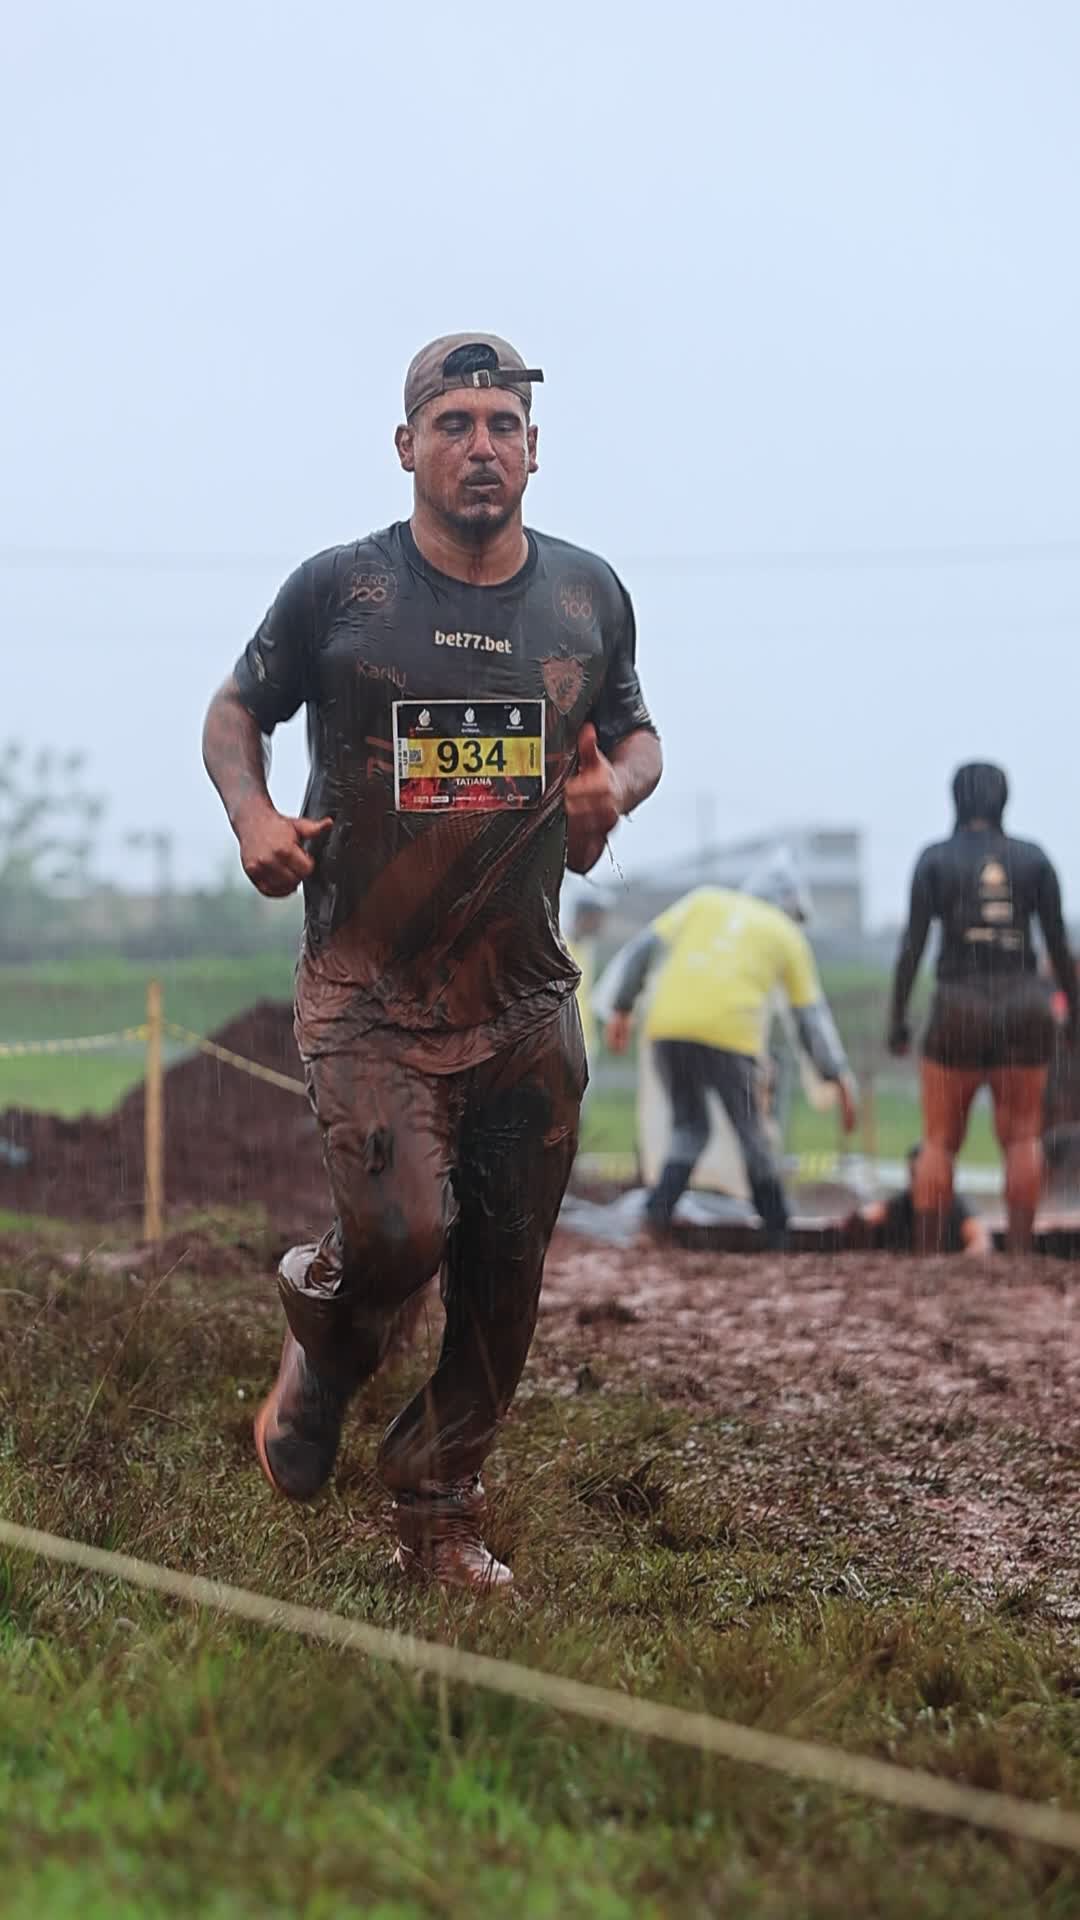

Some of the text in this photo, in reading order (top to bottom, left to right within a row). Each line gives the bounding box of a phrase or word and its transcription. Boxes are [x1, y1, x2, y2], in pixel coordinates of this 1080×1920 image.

[434, 630, 512, 655] bet77.bet
[437, 740, 507, 773] 934
[455, 778, 492, 786] TATIANA
